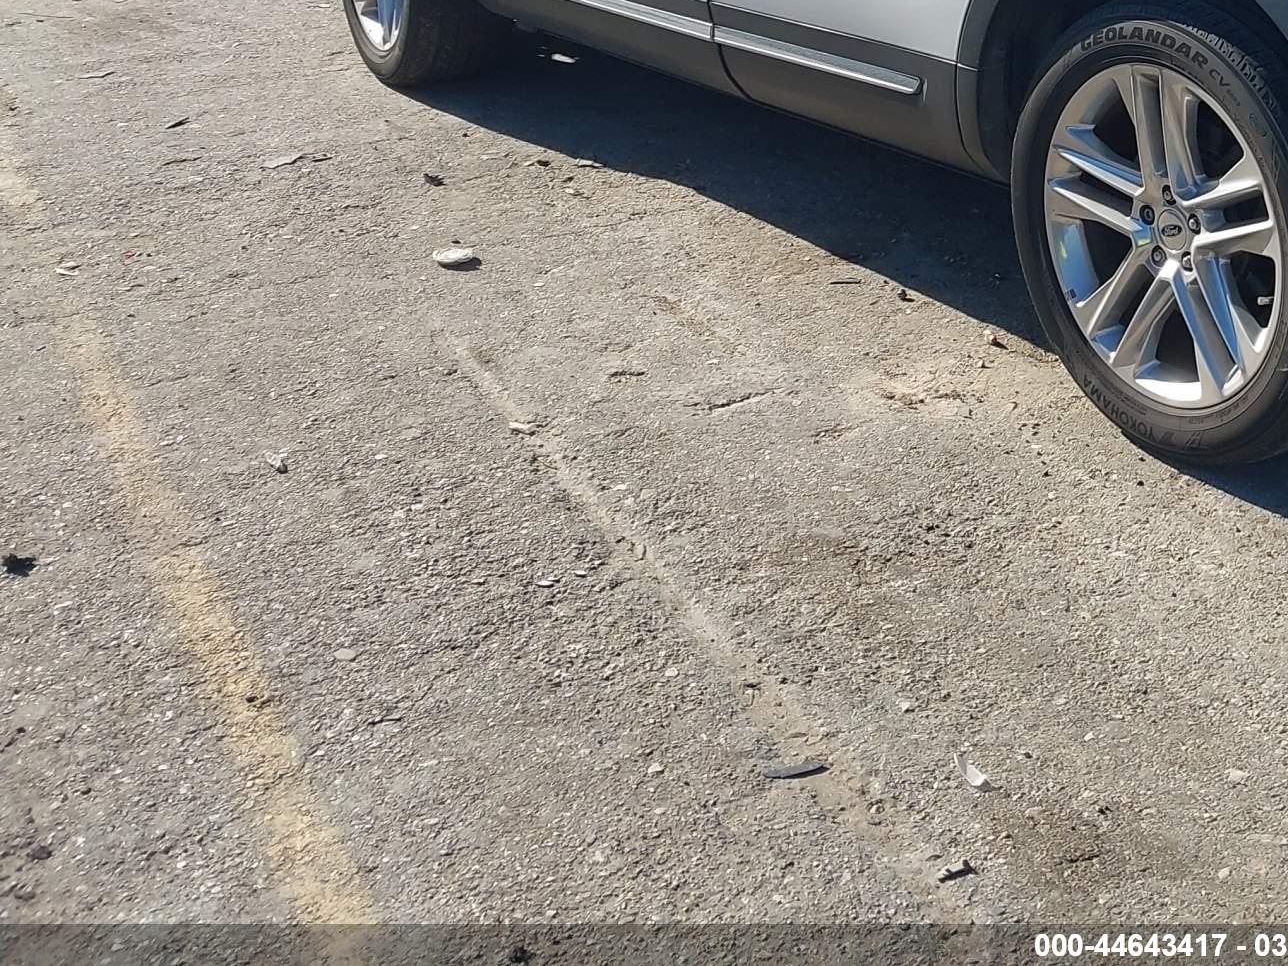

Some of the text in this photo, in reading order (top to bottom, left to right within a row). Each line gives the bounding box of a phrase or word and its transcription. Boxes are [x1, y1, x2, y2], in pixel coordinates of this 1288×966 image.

[1080, 26, 1231, 87] GEOLANDAR CV
[1162, 225, 1181, 236] Ford
[1083, 374, 1157, 442] YOKOHAMA
